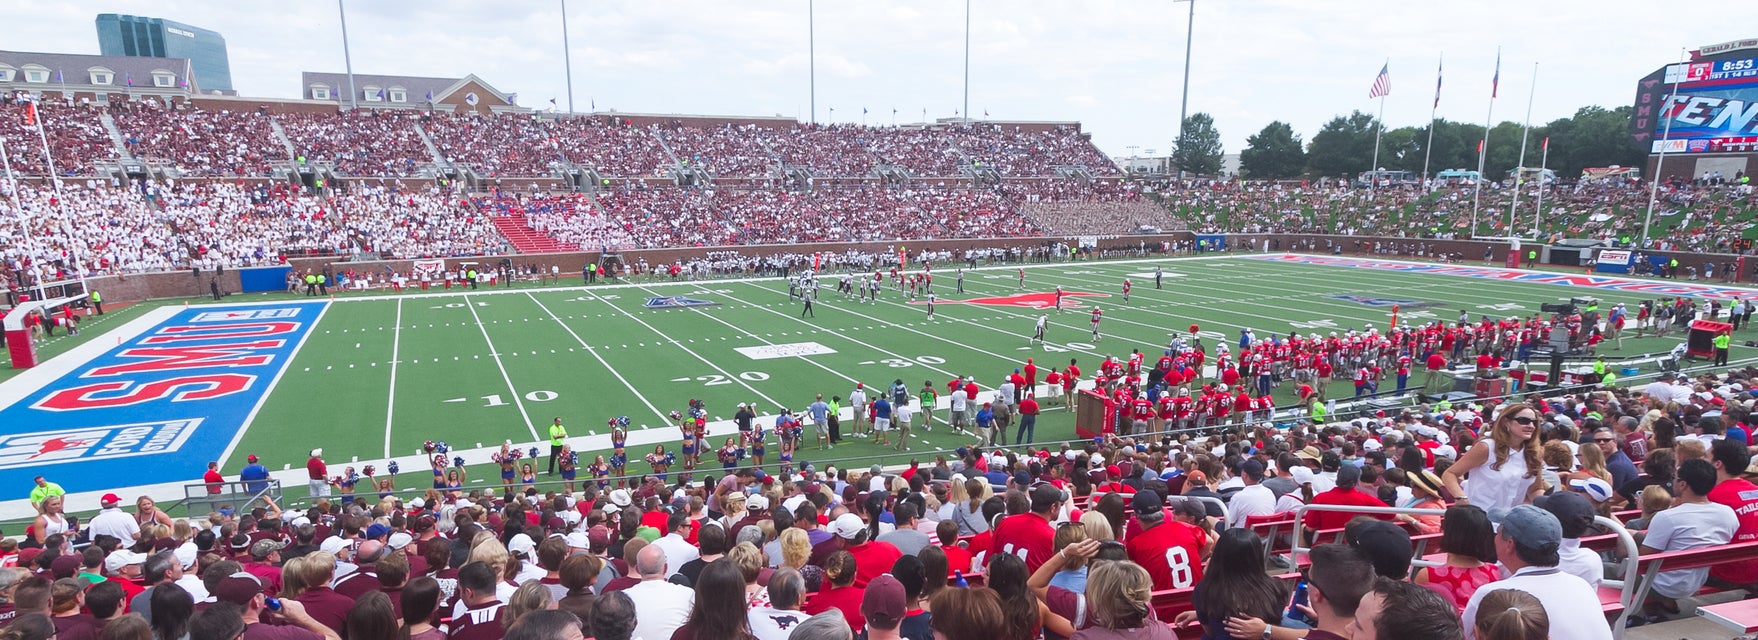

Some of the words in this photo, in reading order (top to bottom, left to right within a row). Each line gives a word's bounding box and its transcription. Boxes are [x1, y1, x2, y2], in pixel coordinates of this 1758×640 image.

[1695, 67, 1704, 76] 0
[1722, 59, 1753, 71] 8:53
[1637, 93, 1652, 129] SMU
[1041, 340, 1097, 352] 40
[28, 321, 303, 412] SMU
[880, 355, 946, 368] 30
[696, 371, 771, 386] 20
[480, 390, 559, 407] 10
[93, 426, 154, 456] FORD
[1165, 545, 1194, 589] 8
